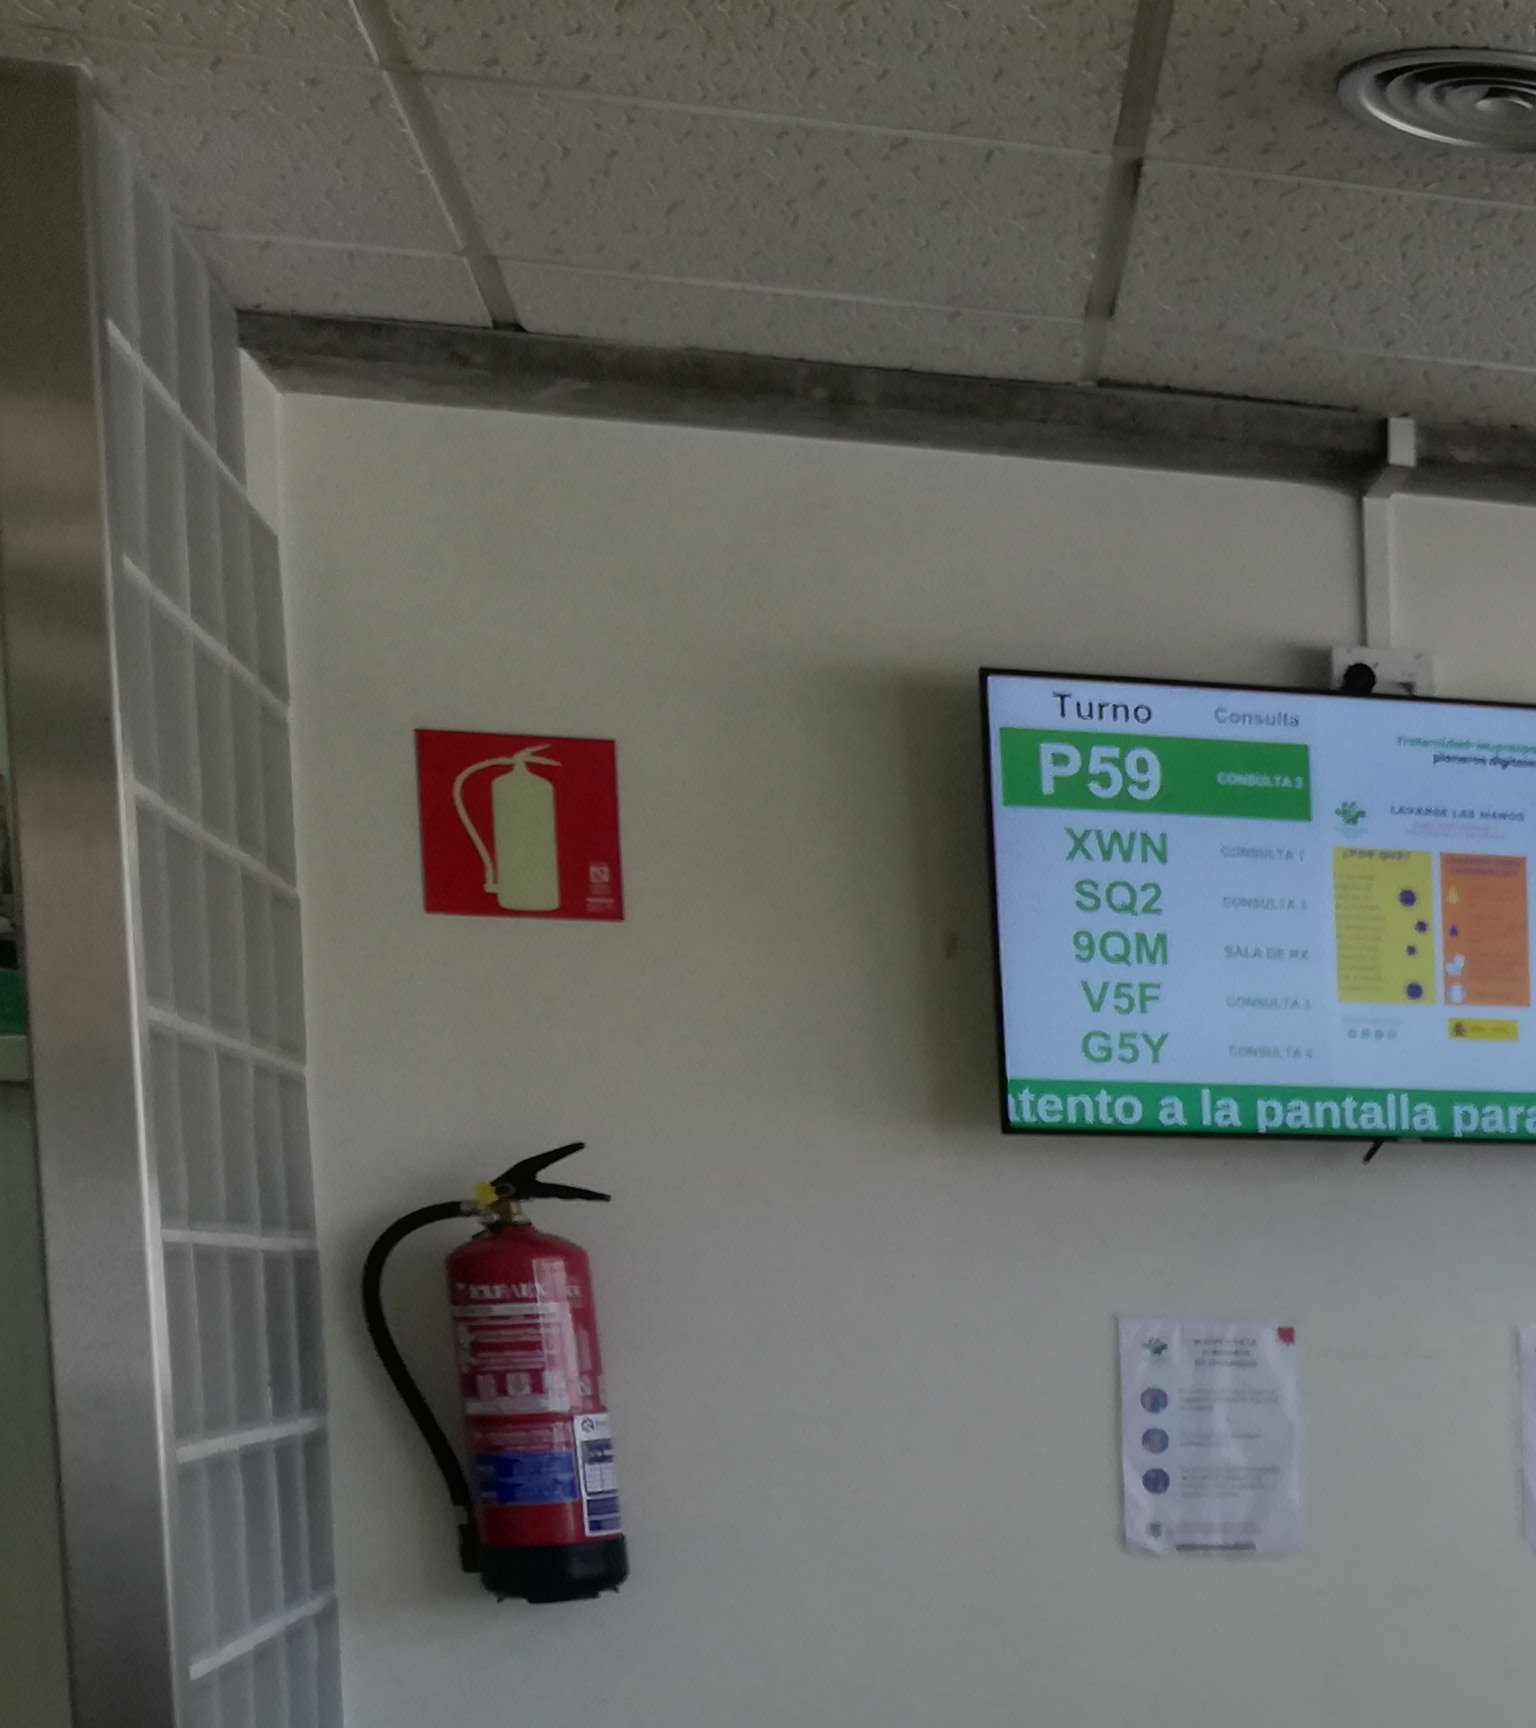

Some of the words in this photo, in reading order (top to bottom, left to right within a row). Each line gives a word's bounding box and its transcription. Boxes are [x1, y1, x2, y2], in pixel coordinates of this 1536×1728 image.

[1053, 692, 1152, 724] Turno
[1214, 707, 1300, 728] Consulta
[1039, 742, 1162, 801] P59
[1064, 826, 1169, 865] XWN
[1073, 879, 1164, 917] SQ2
[1072, 929, 1169, 967] 9QM
[1080, 979, 1162, 1016] V5F
[1080, 1029, 1170, 1066] G5Y
[1158, 1095, 1188, 1127] a
[1200, 1087, 1242, 1130] la
[1255, 1091, 1441, 1134] pantalla
